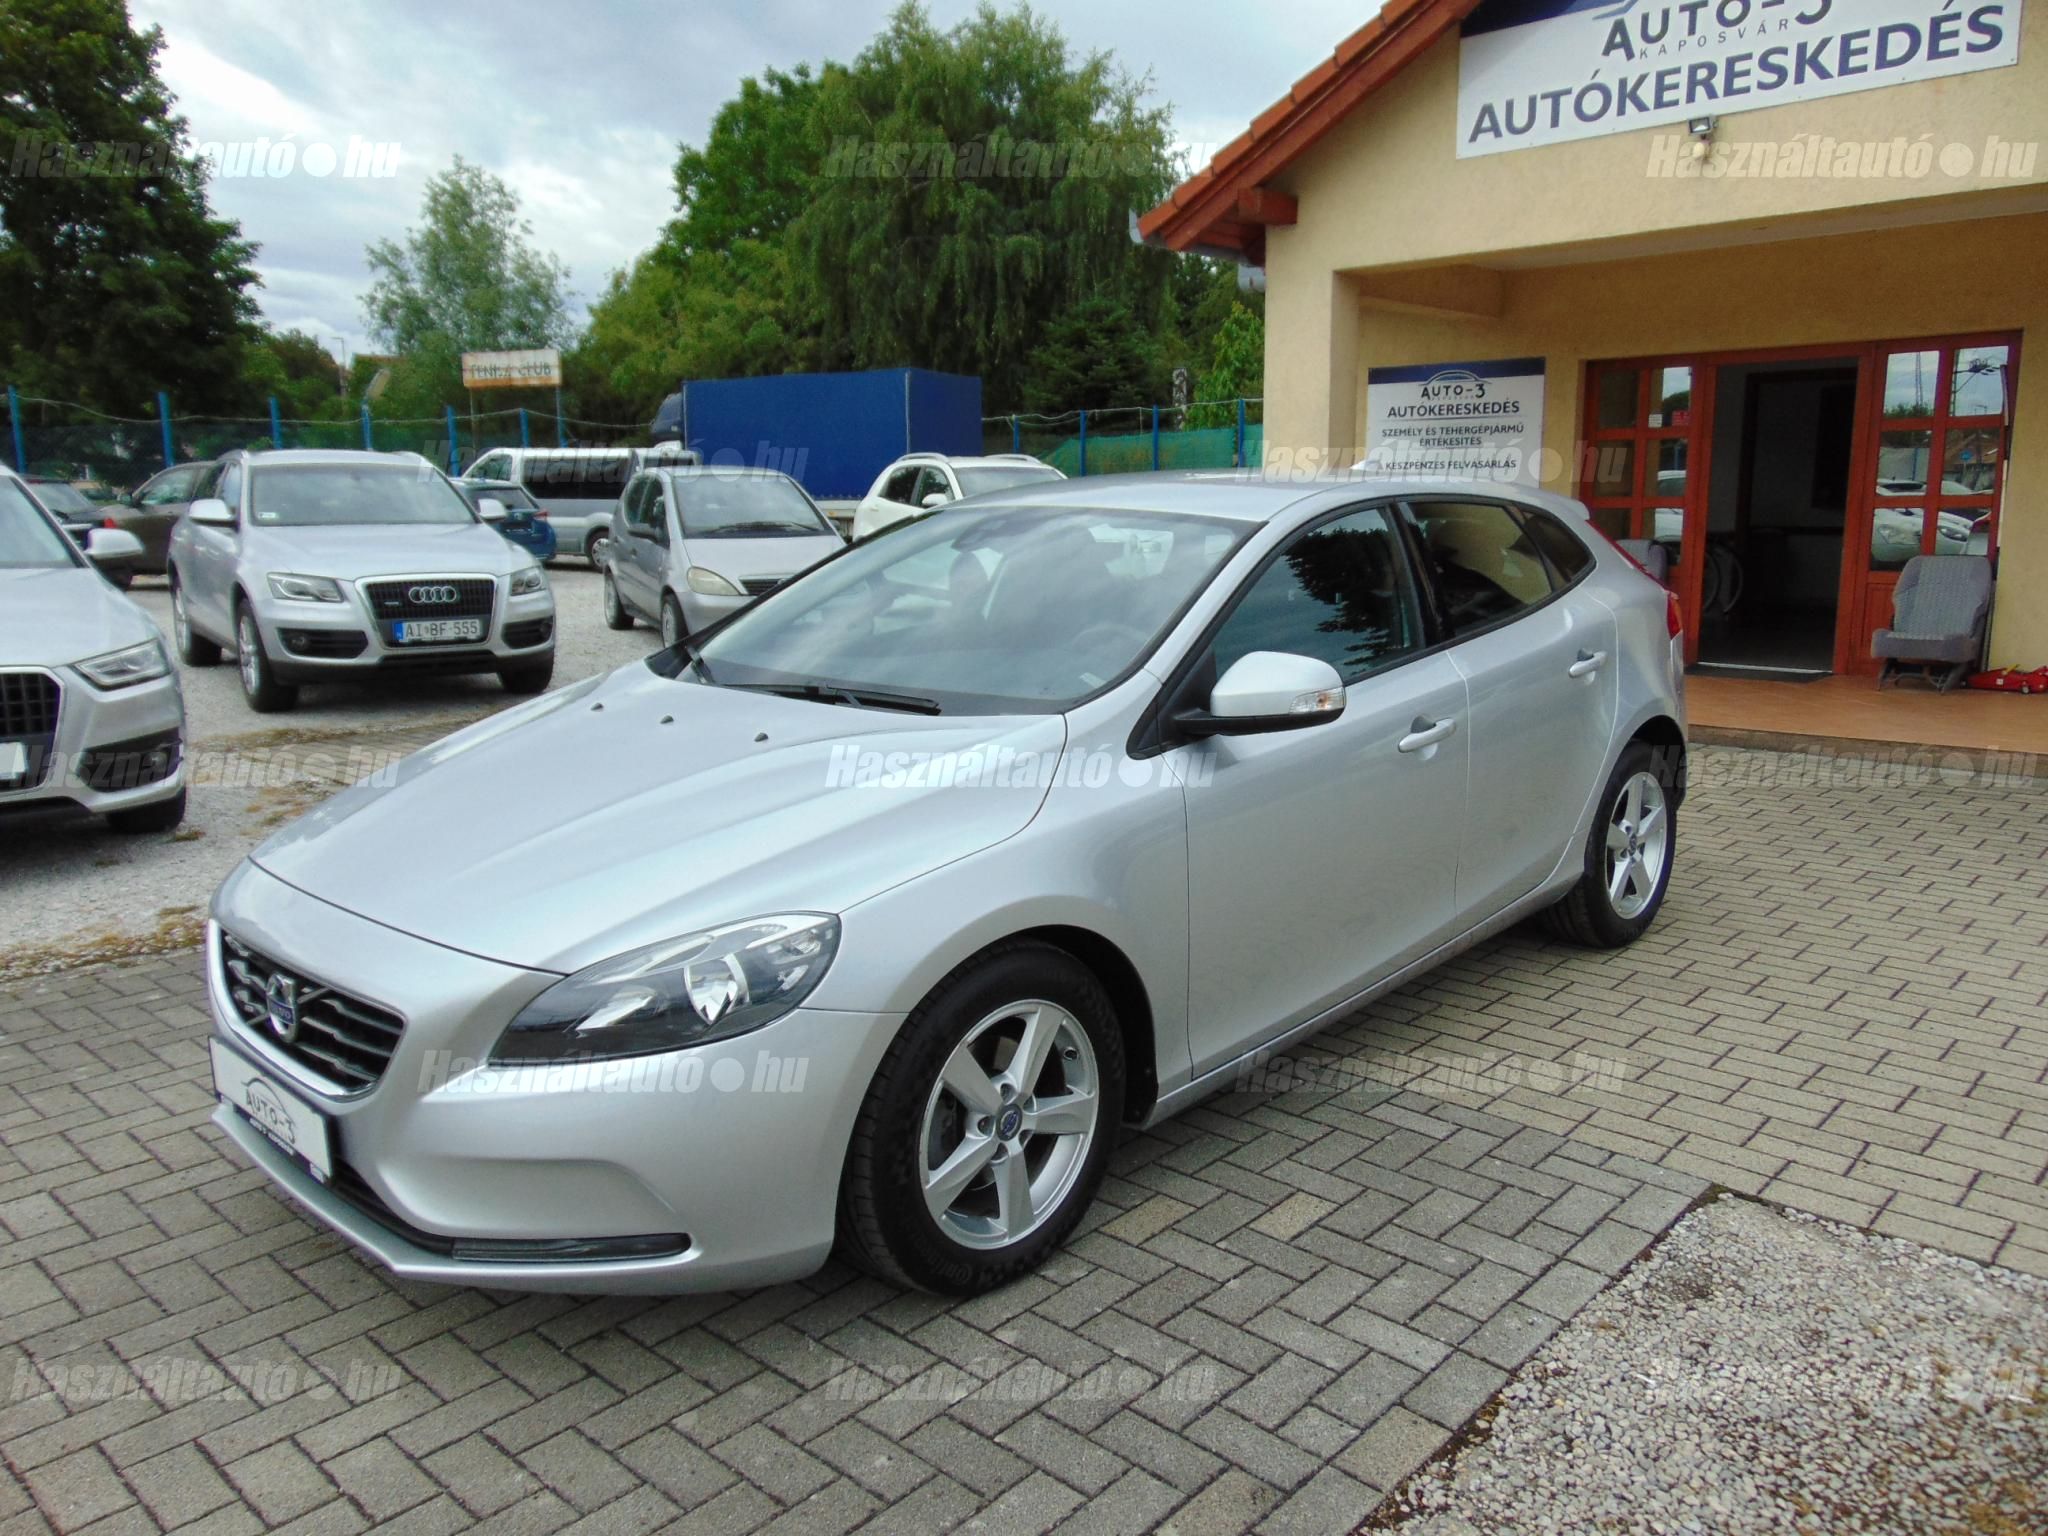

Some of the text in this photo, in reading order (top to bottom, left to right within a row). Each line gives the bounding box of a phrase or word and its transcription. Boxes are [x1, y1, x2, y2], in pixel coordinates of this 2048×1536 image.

[1639, 18, 1789, 60] KAPOSVÁR
[1467, 0, 2005, 144] AUTÓKERESKEDÉS
[518, 360, 552, 377] CLUB
[1421, 383, 1485, 399] AUTO-3
[1387, 397, 1520, 418] AUTÓKERESKEDÉS
[1382, 425, 1423, 438] SZEMÉLY
[1425, 424, 1436, 436] ÉS
[246, 1089, 295, 1145] AUTO-3
